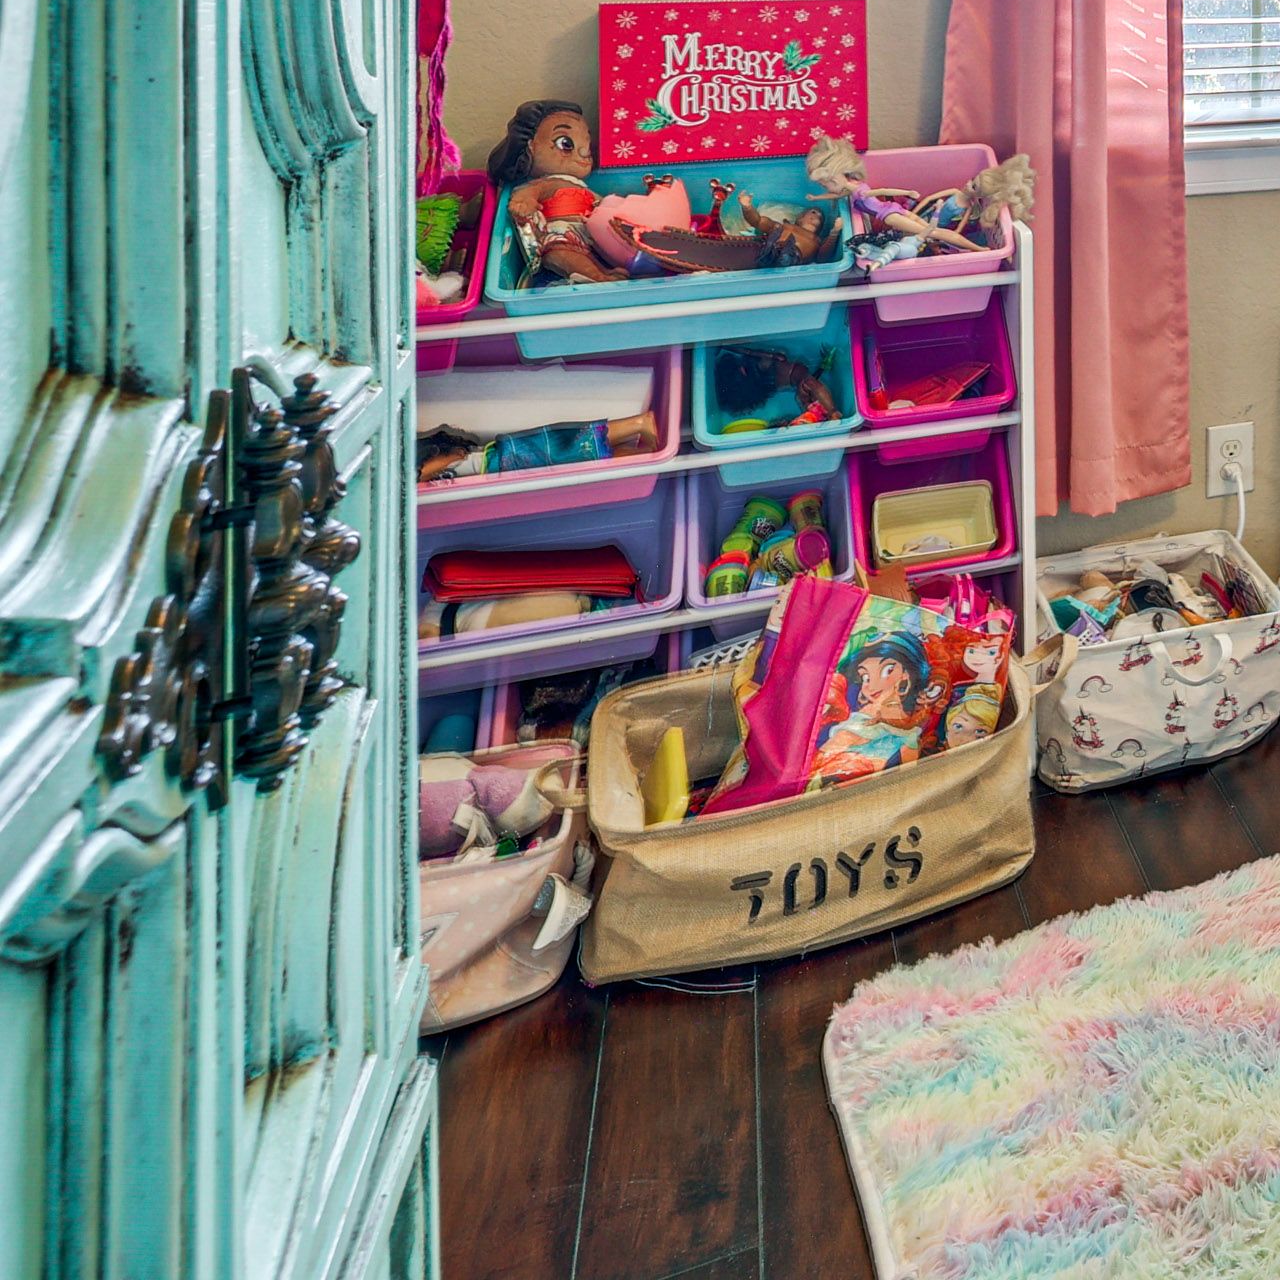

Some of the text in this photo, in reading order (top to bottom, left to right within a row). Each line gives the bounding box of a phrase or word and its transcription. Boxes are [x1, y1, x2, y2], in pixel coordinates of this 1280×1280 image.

[661, 31, 784, 80] MERRY
[655, 73, 818, 126] CHRISTMAS
[729, 825, 924, 925] TOYS
